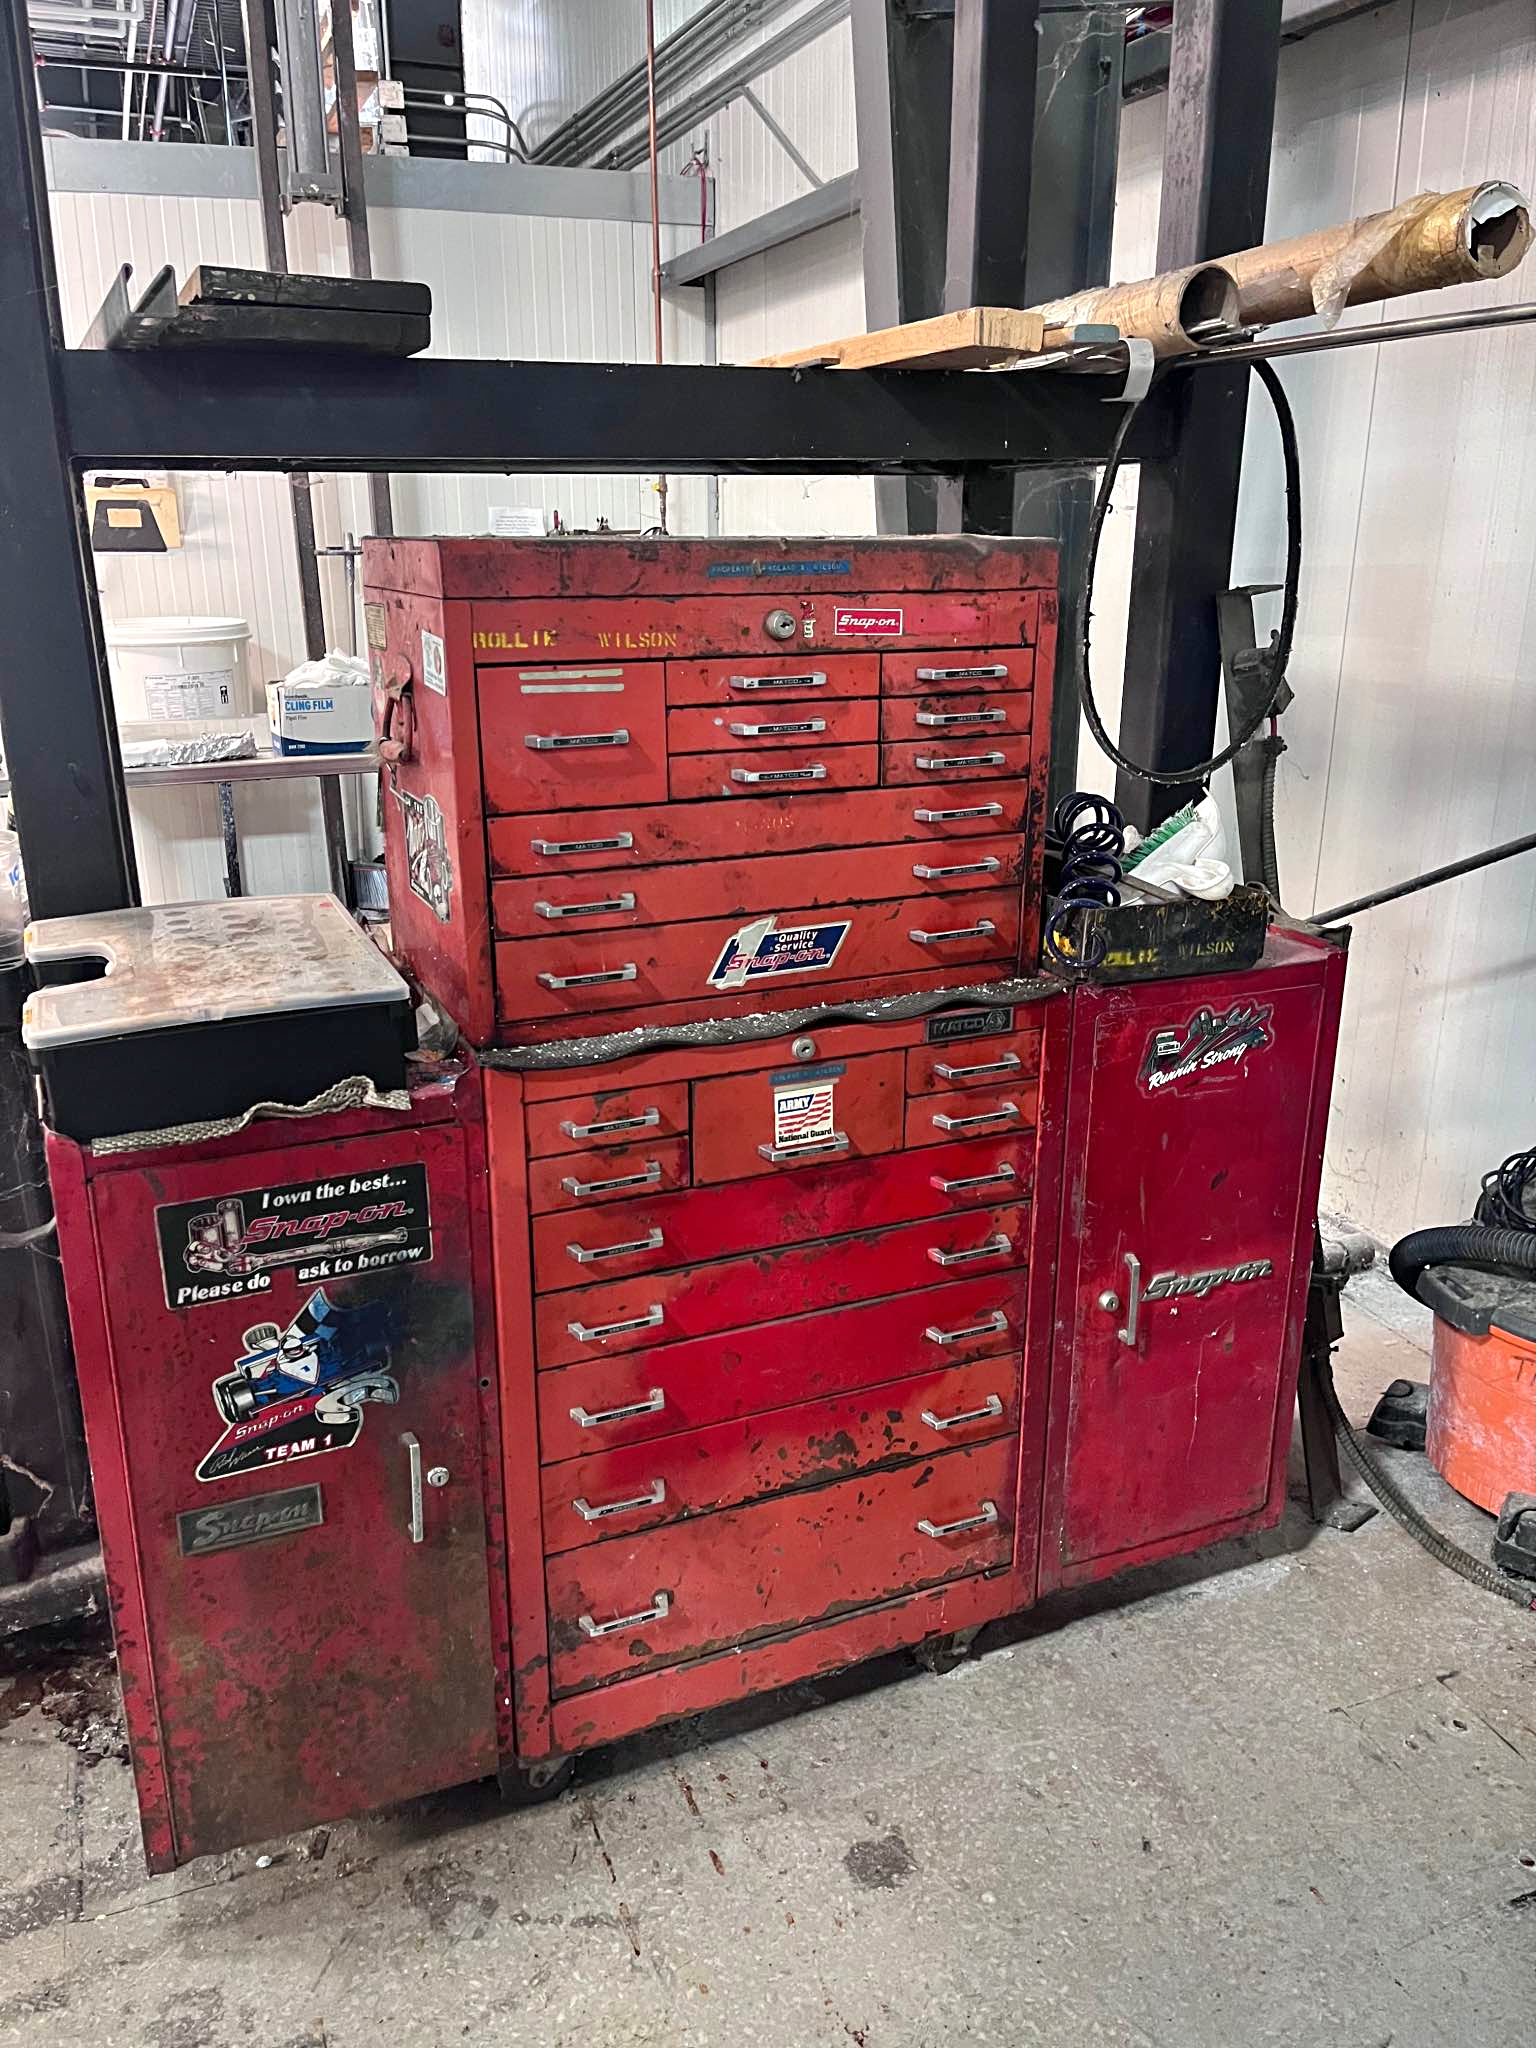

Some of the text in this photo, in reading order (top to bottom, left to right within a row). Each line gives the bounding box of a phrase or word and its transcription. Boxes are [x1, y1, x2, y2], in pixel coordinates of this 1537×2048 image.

[838, 613, 897, 629] Snap-on
[597, 632, 678, 649] WILSON
[284, 699, 334, 711] CLING FILM
[774, 940, 814, 952] Service
[778, 930, 818, 943] Quality
[724, 948, 826, 972] Snap-on
[1177, 940, 1235, 961] WILSON
[933, 1017, 985, 1035] MATCO
[1201, 1043, 1248, 1070] Strong
[778, 1095, 812, 1113] ARMY
[778, 1127, 832, 1144] National Guard
[262, 1173, 407, 1208] I own the best...
[241, 1200, 407, 1245] Snap-on
[176, 1246, 424, 1304] Please do ask to borrow
[1140, 1258, 1273, 1302] Snap-on
[234, 1404, 305, 1440] Snap-on
[265, 1438, 315, 1460] TEAM
[323, 1434, 333, 1446] 1
[192, 1502, 311, 1547] Snap-on
